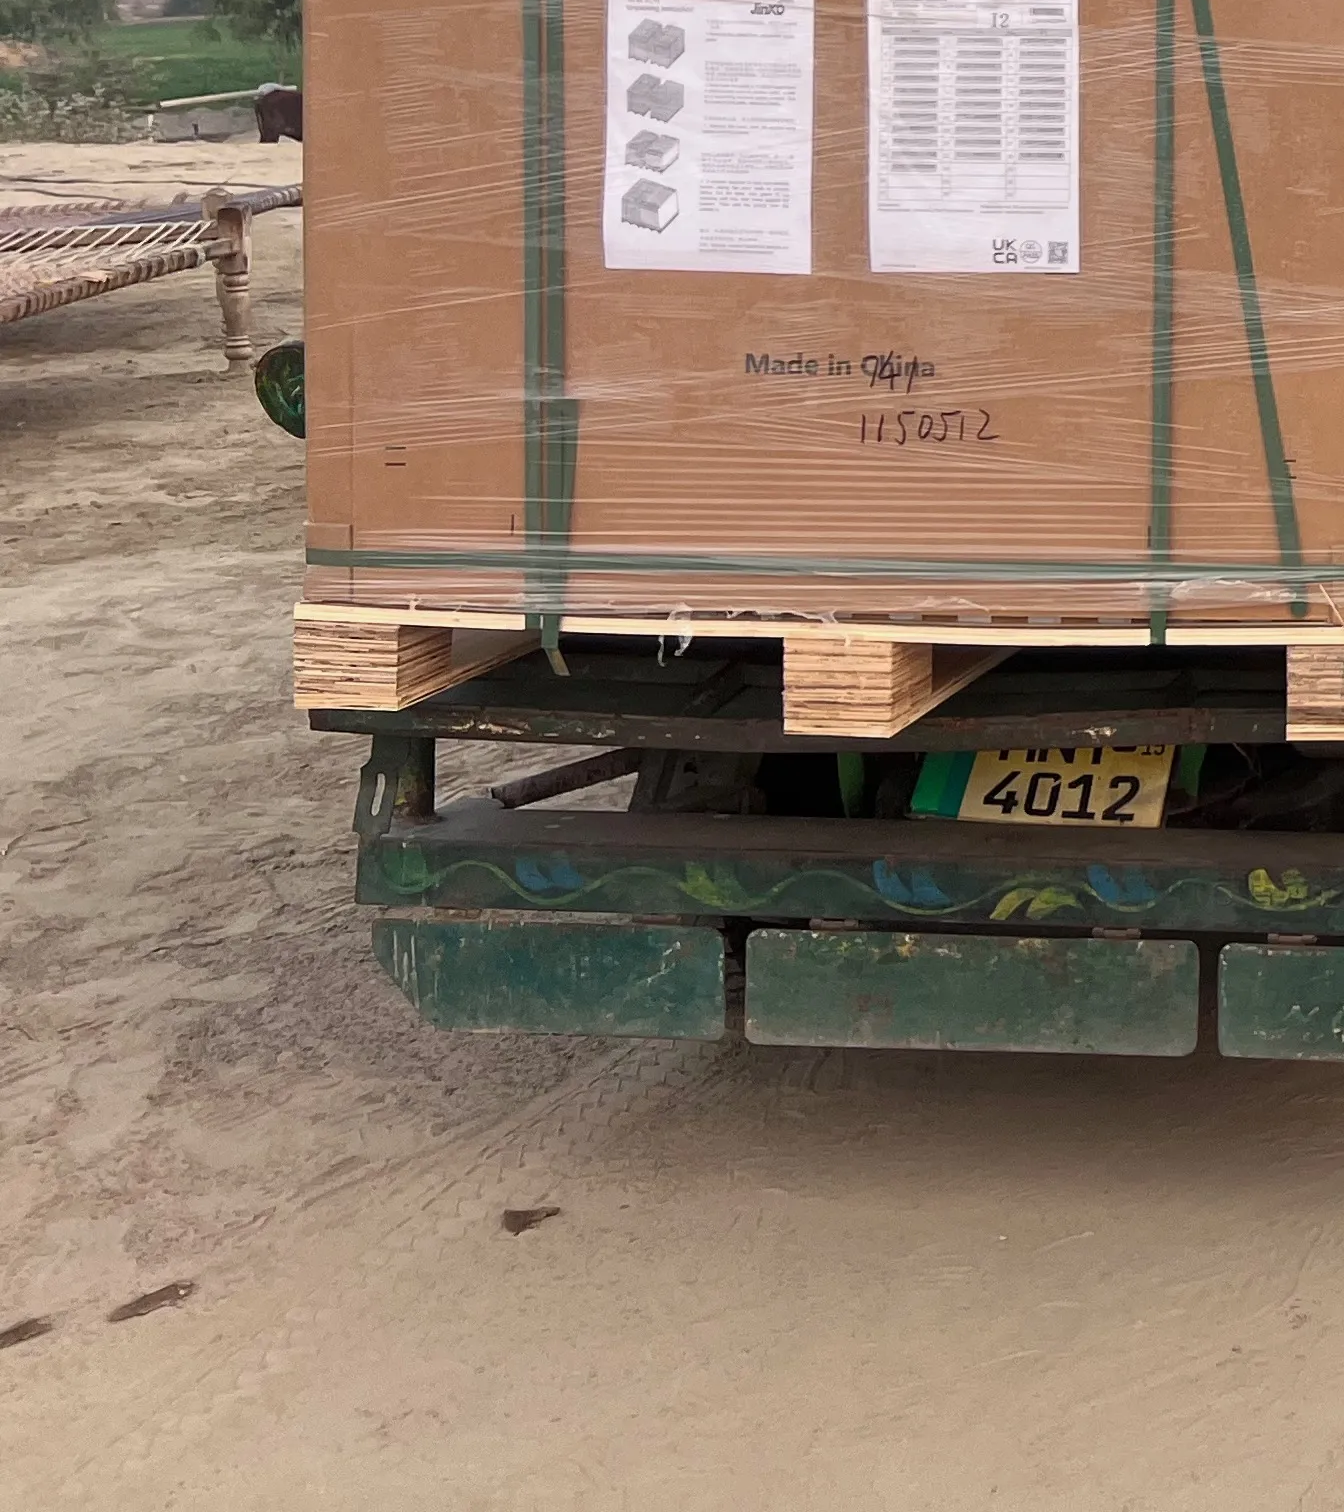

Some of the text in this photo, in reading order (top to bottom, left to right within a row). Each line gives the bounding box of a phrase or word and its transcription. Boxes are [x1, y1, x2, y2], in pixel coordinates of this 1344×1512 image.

[993, 239, 1017, 251] UK
[993, 253, 1018, 264] CA
[744, 352, 935, 377] Made in China
[859, 408, 1000, 445] 1150512
[982, 771, 1141, 821] 4012
